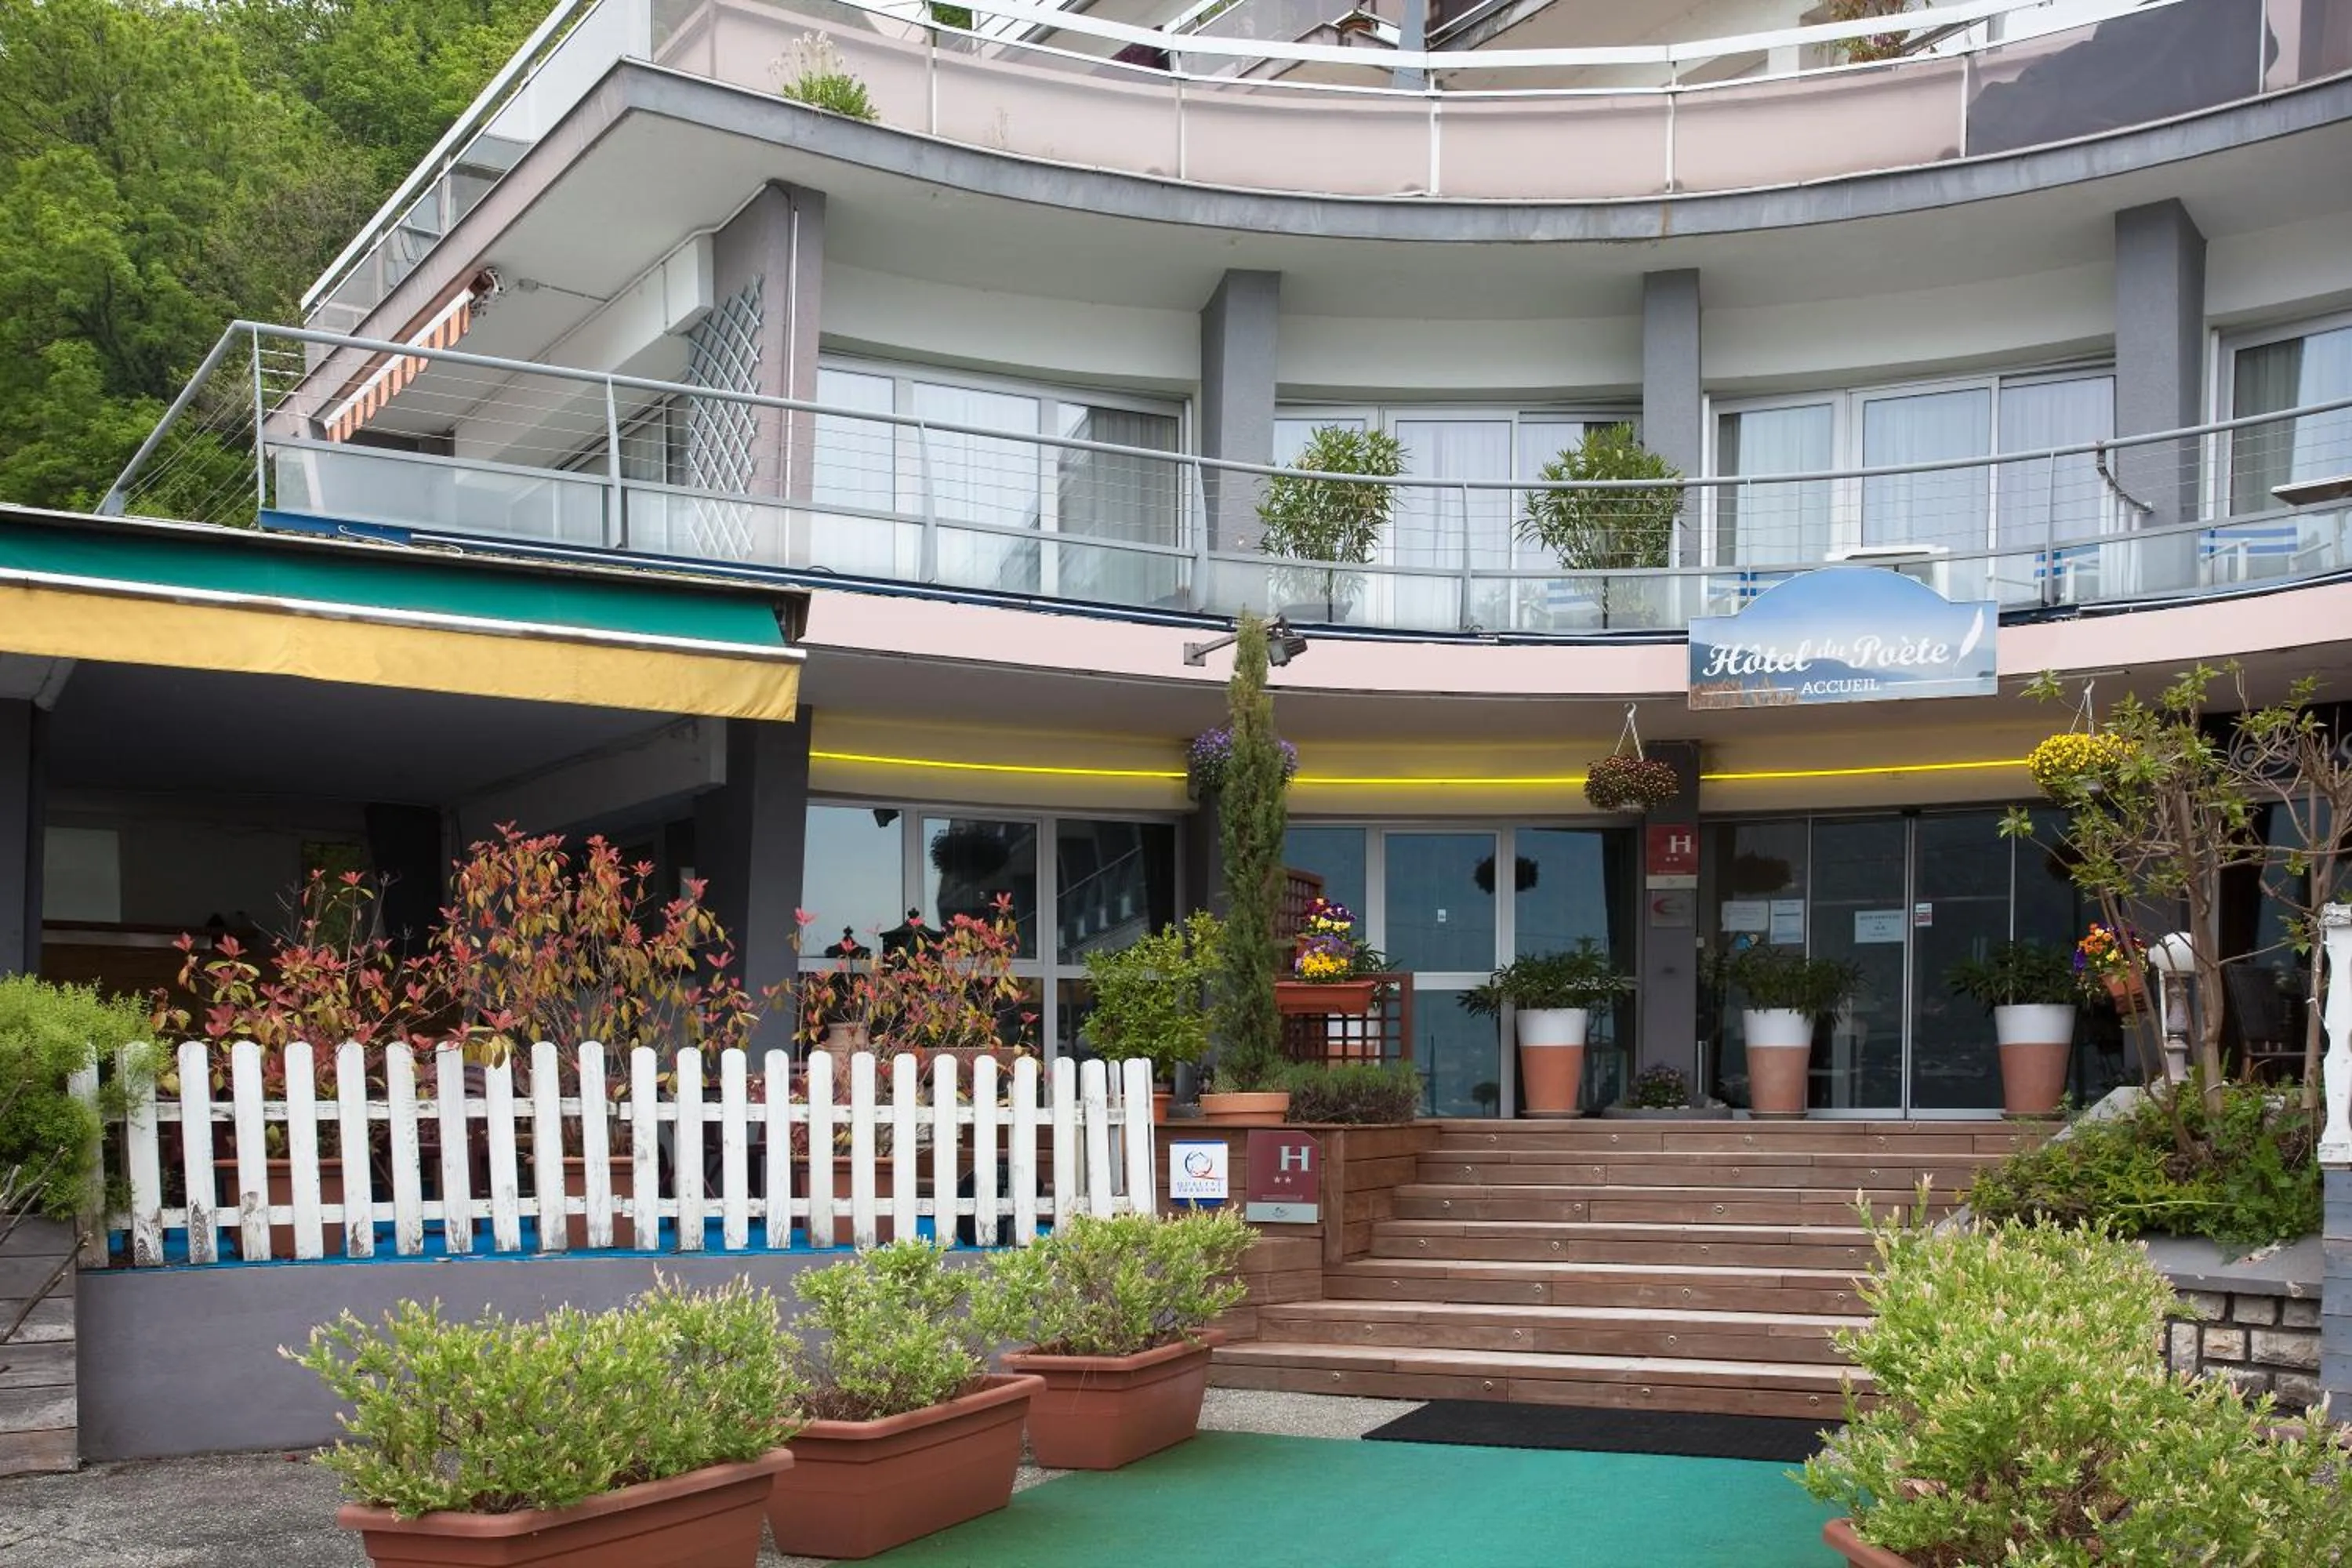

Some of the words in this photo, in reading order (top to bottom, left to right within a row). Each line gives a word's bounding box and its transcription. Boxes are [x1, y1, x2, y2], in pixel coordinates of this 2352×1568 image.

[1702, 639, 1813, 677] Hôtel
[1814, 638, 1846, 659] du
[1848, 634, 1951, 668] Poète
[1801, 678, 1881, 695] ACCUEIL
[1669, 835, 1691, 854] H
[1279, 1145, 1312, 1171] H
